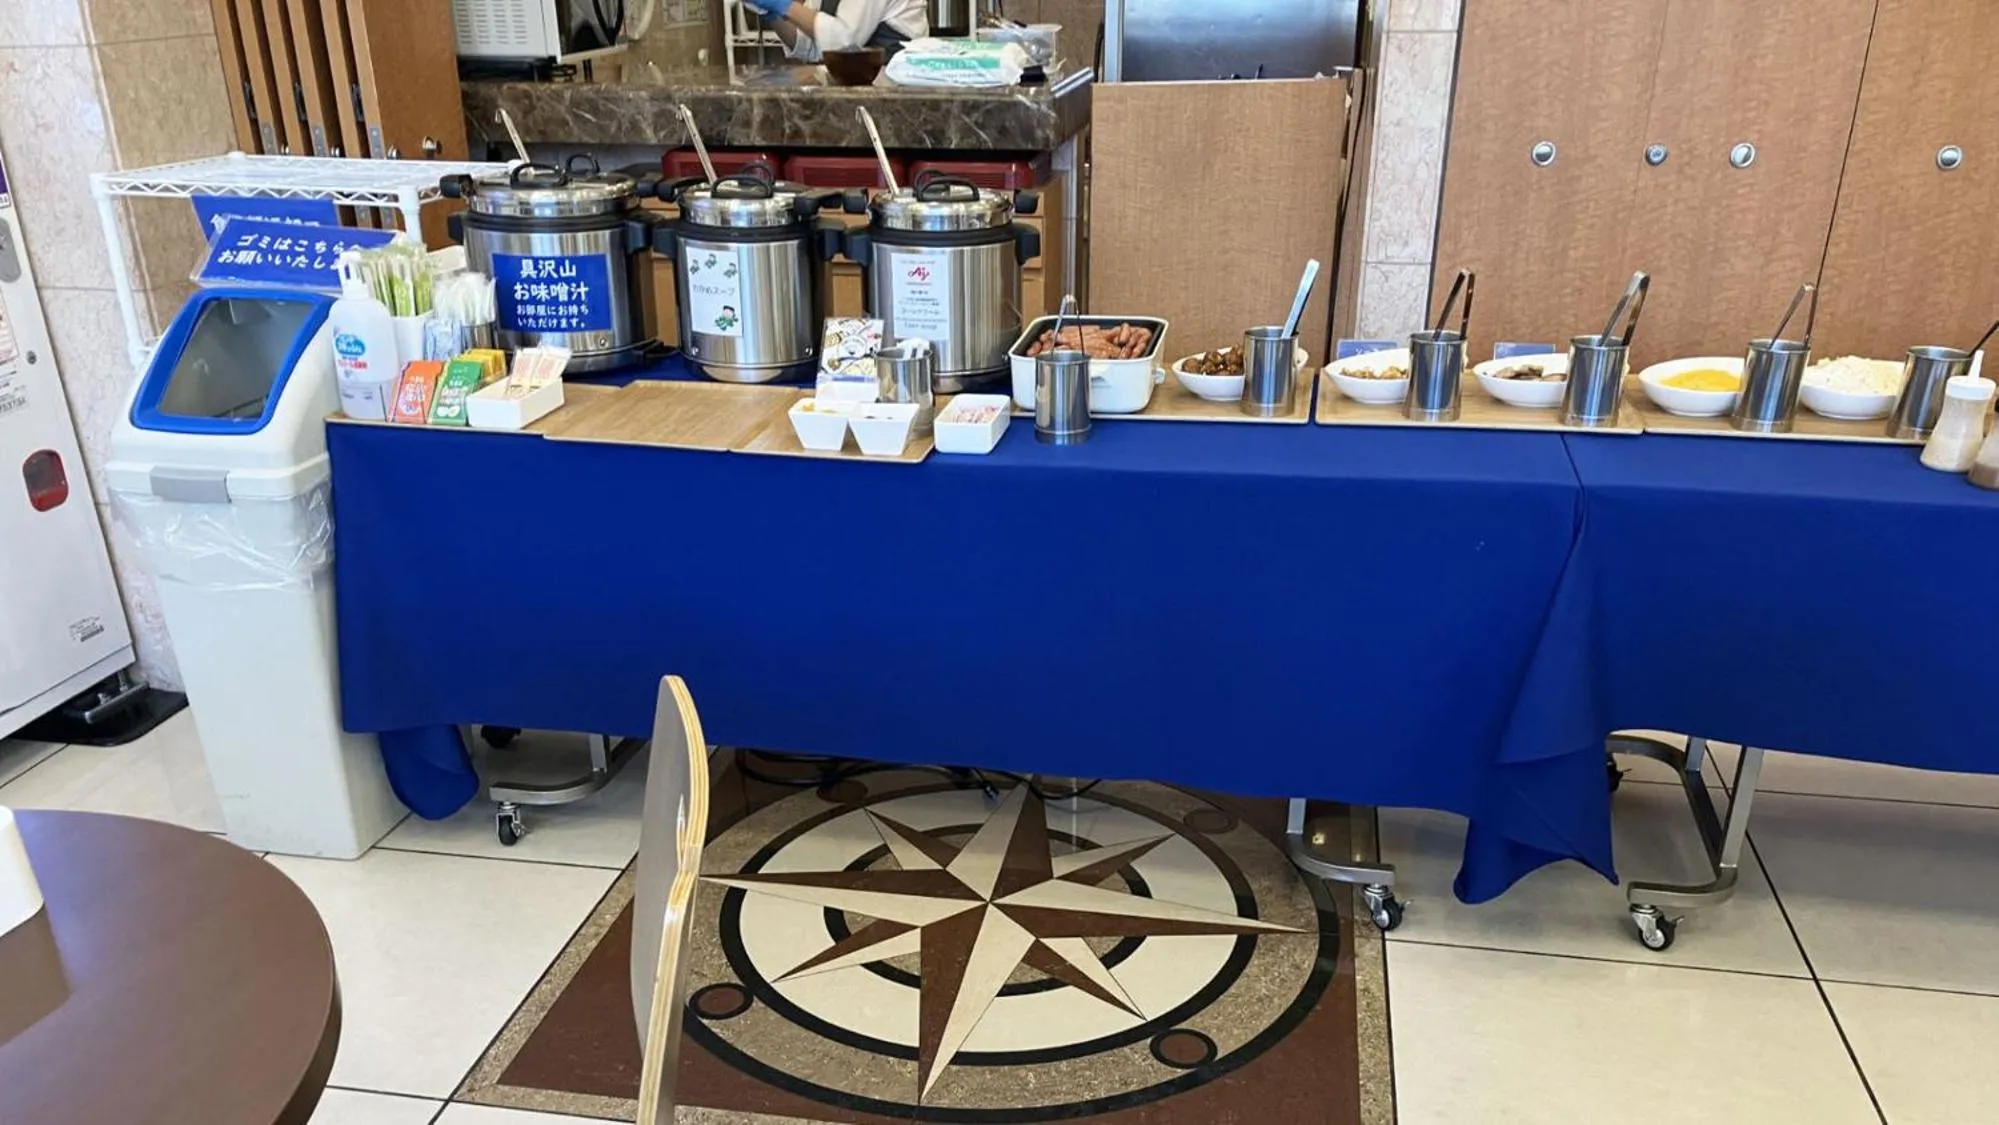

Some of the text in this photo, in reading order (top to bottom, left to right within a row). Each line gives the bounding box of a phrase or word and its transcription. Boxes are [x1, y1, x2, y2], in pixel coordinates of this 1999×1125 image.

[519, 258, 577, 278] 具沢山
[513, 281, 590, 302] お味噌汁
[516, 304, 589, 317] お部屋にお持ち
[517, 317, 586, 329] いただけます。
